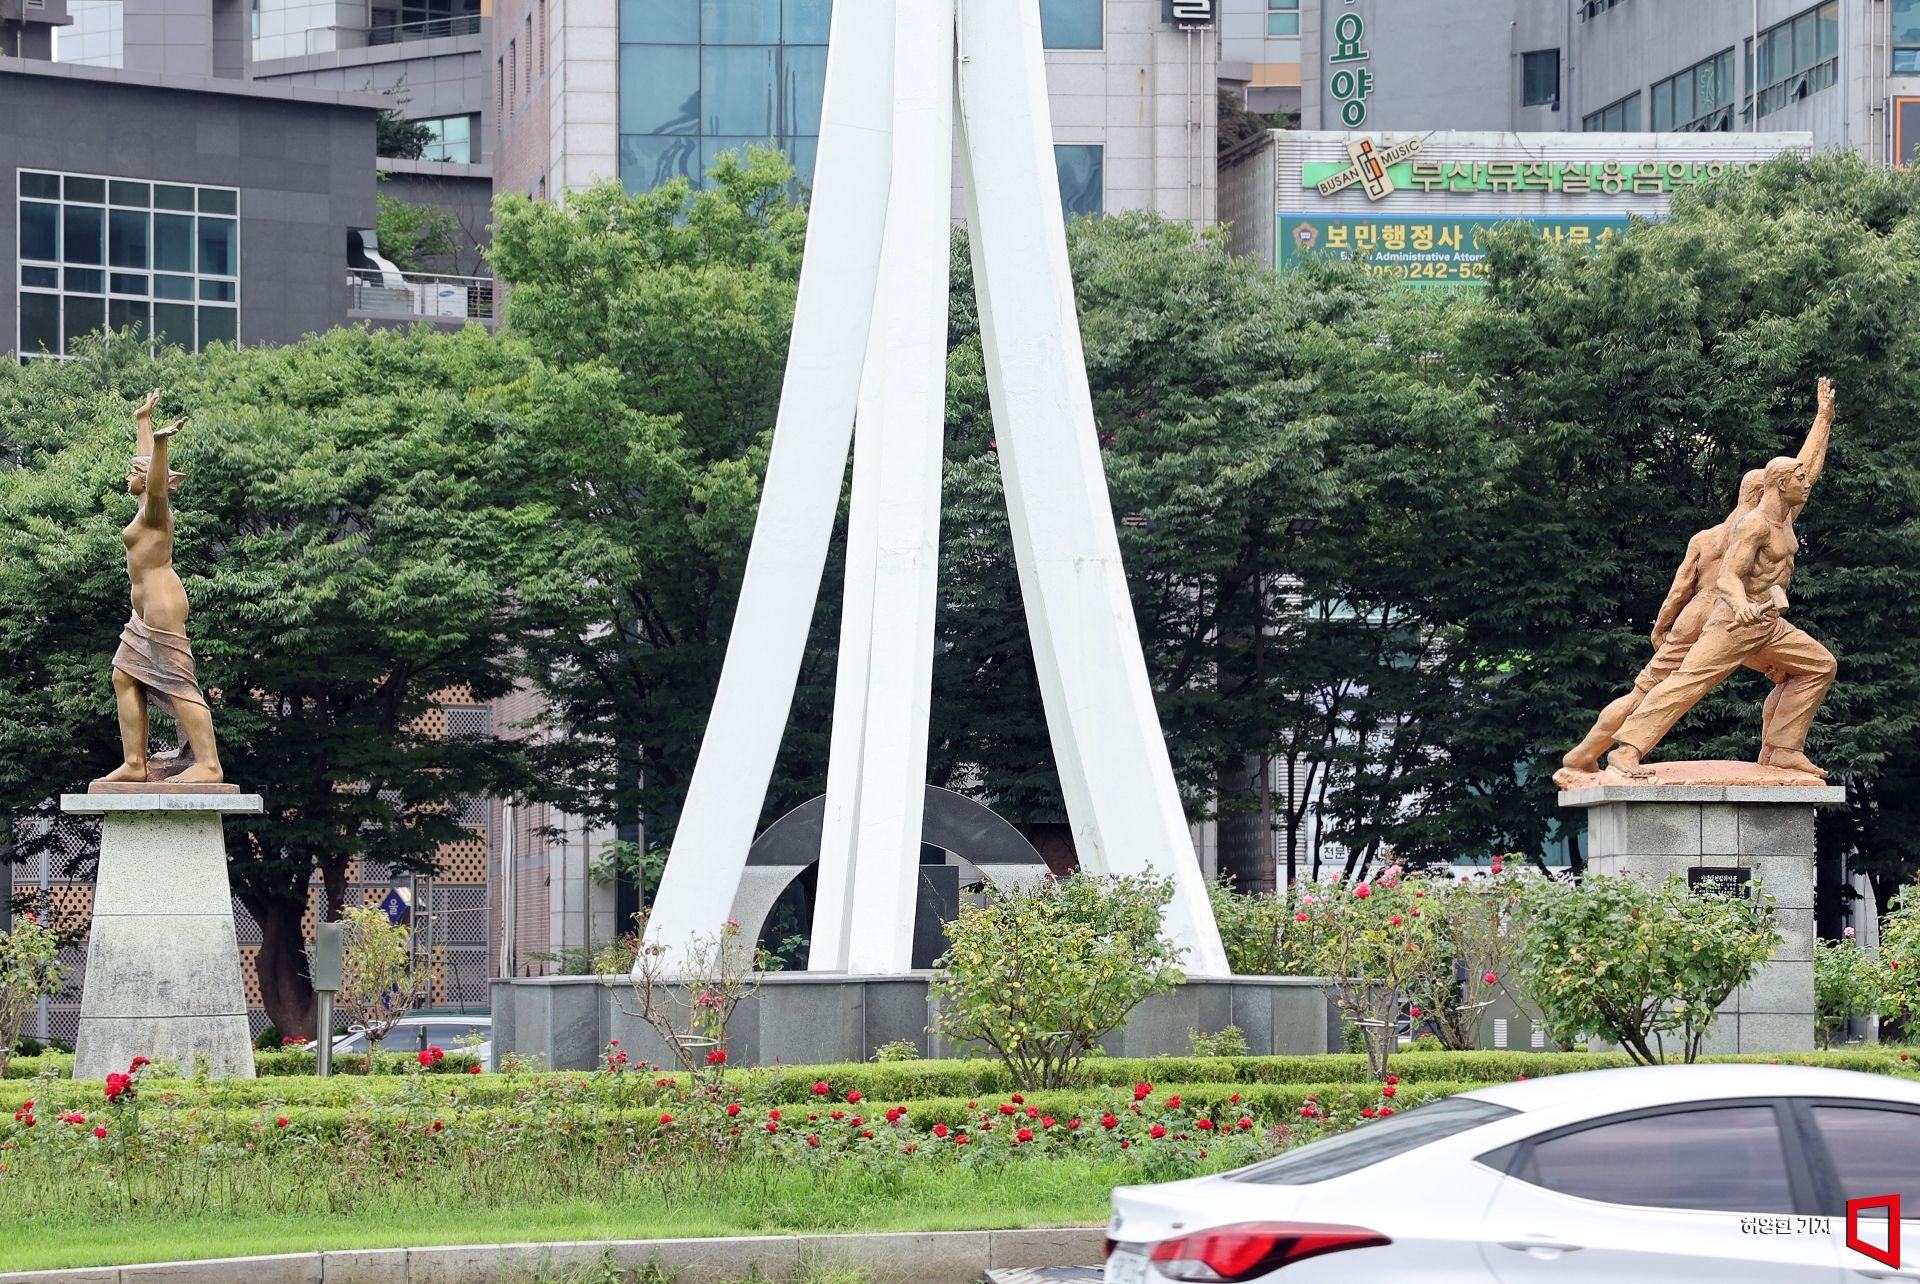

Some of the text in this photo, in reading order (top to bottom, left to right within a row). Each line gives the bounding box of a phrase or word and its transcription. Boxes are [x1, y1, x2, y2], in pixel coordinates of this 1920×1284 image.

[1320, 139, 1420, 194] BUSAN MUSIC
[1325, 224, 1463, 251] 보민행정사
[1376, 251, 1450, 261] Administrative
